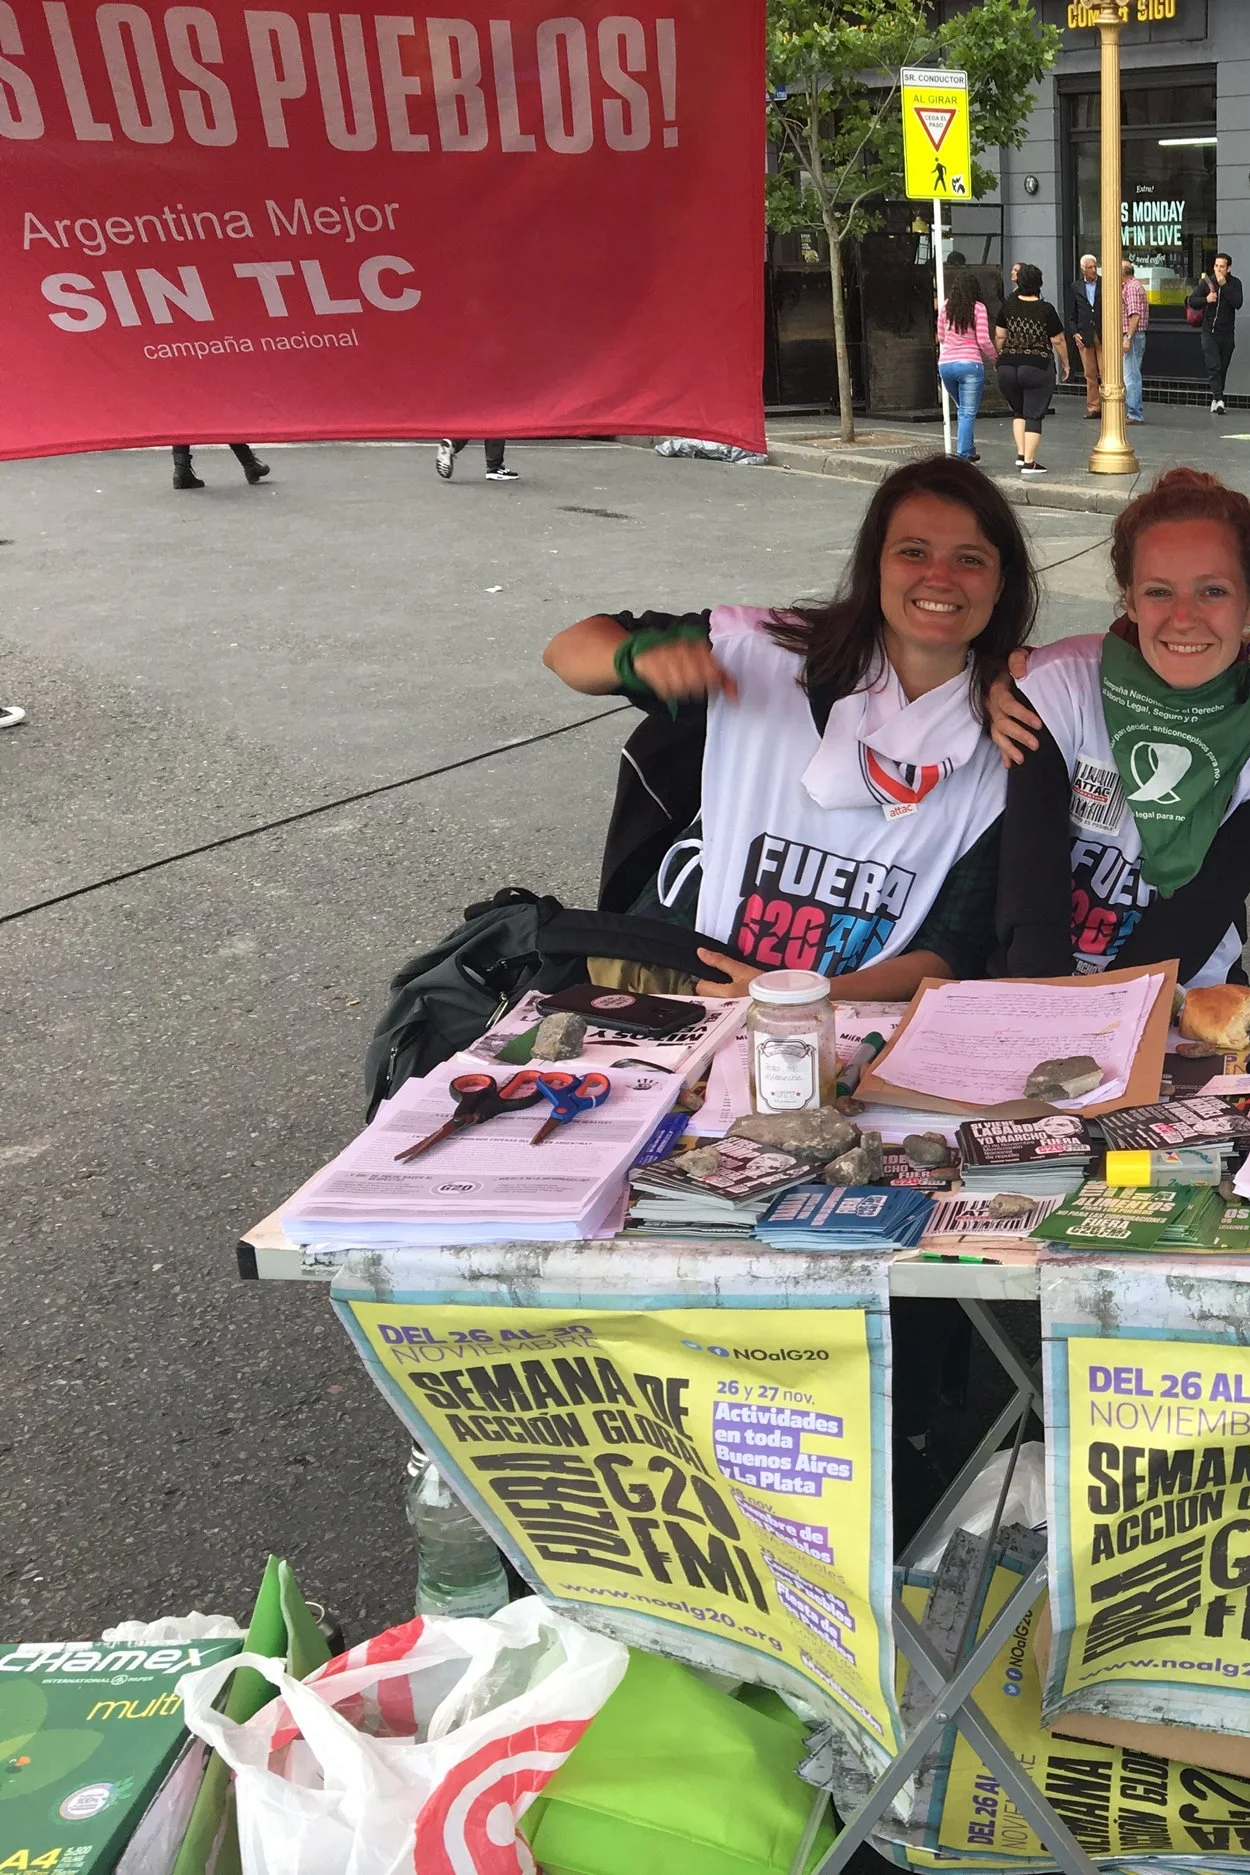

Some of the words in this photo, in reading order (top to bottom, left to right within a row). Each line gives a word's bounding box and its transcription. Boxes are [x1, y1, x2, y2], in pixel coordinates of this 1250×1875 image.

[1137, 0, 1176, 21] SIGO
[44, 0, 239, 150] LOS
[246, 10, 680, 154] PUEBLOS!
[905, 73, 916, 82] SR.
[918, 74, 965, 84] CONDUCTOR
[913, 94, 925, 104] AL
[928, 95, 958, 105] GIRAR
[925, 114, 940, 122] CEDA
[940, 114, 947, 122] EL
[929, 121, 944, 129] PASO
[1132, 200, 1185, 223] MONDAY
[22, 204, 255, 257] Argentina
[264, 196, 402, 245] Mejor
[1133, 225, 1146, 246] IN
[1149, 225, 1182, 246] LOVE
[40, 265, 215, 334] SIN
[234, 255, 423, 318] TLC
[142, 334, 254, 362] campaña
[260, 328, 360, 354] nacional
[1126, 699, 1151, 716] Legal,
[1152, 708, 1183, 722] Seguro
[1183, 715, 1190, 723] y
[1191, 704, 1225, 716] Derecho
[1073, 777, 1112, 799] ATTAC
[888, 802, 914, 819] attac
[1156, 812, 1174, 821] para
[748, 832, 917, 919] FUERA
[972, 1122, 1043, 1138] LAGARDE
[977, 1137, 995, 1145] YO
[996, 1131, 1048, 1144] MARCHO
[1039, 1137, 1081, 1146] FUERA
[1071, 1197, 1176, 1212] ALIMENTOS
[1081, 1217, 1130, 1230] FUERA
[377, 1323, 449, 1346] DEL
[448, 1328, 494, 1344] 26
[499, 1327, 547, 1342] AL
[547, 1324, 593, 1338] 30
[391, 1335, 602, 1365] NOVIEMBRE
[732, 1348, 830, 1362] NOalG20
[716, 1380, 740, 1396] 26
[743, 1386, 754, 1400] y
[757, 1385, 780, 1402] 27
[783, 1390, 816, 1406] nov.
[1088, 1365, 1154, 1397] DEL
[1160, 1371, 1203, 1401] 26
[407, 1355, 639, 1414] SEMANA
[633, 1372, 695, 1443] DE
[714, 1402, 839, 1435] Actividades
[444, 1411, 591, 1448] ACCIÓN
[591, 1409, 717, 1482] GLOBAL
[714, 1429, 741, 1443] en
[743, 1429, 793, 1449] toda
[714, 1444, 792, 1471] Buenos
[794, 1453, 850, 1479] Aires
[732, 1467, 758, 1486] La
[760, 1471, 816, 1495] Plata
[593, 1452, 741, 1542] G20
[469, 1453, 644, 1577] FUERA
[627, 1516, 770, 1616] FMI
[559, 1582, 784, 1653] www.noalg20.org
[42, 1677, 110, 1685] INTERNATIONAL
[971, 1791, 999, 1819] 26
[967, 1820, 996, 1846] DEL
[0, 1847, 63, 1871] A4
